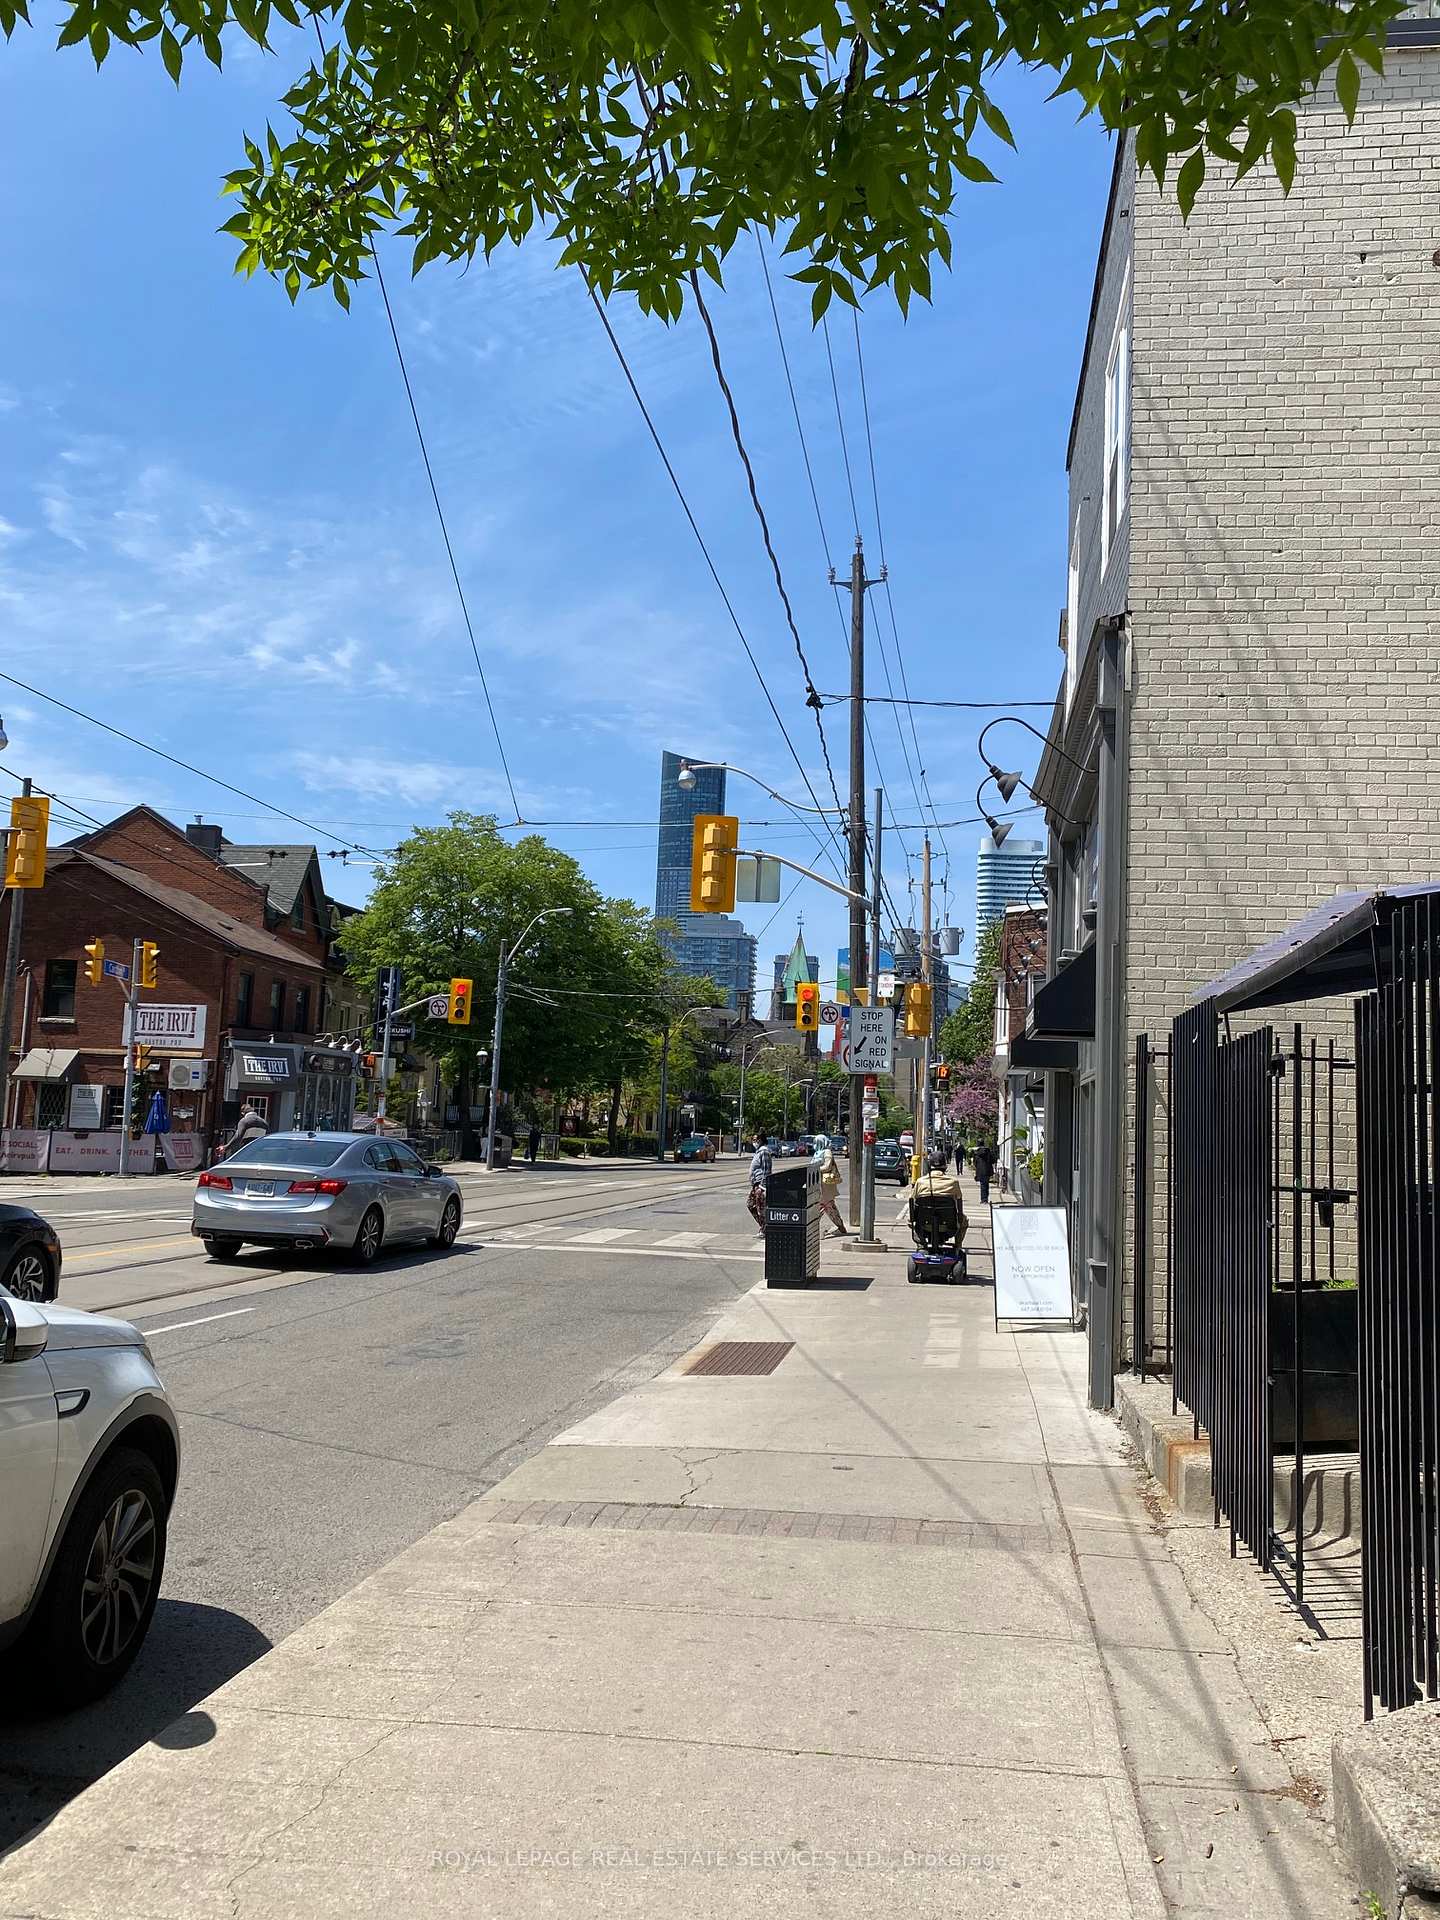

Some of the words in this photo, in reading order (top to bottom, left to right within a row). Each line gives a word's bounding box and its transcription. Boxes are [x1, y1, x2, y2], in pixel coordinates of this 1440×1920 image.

[861, 1011, 884, 1021] STOP
[140, 1012, 164, 1031] THE
[166, 1012, 190, 1031] IRV
[861, 1024, 884, 1033] HERE
[875, 1036, 888, 1045] ON
[869, 1048, 887, 1057] RED
[248, 1059, 267, 1072] THE
[855, 1059, 887, 1069] SIGNAL
[769, 1211, 788, 1221] Litter
[1011, 1264, 1031, 1273] NOW
[1033, 1264, 1056, 1273] OPEN
